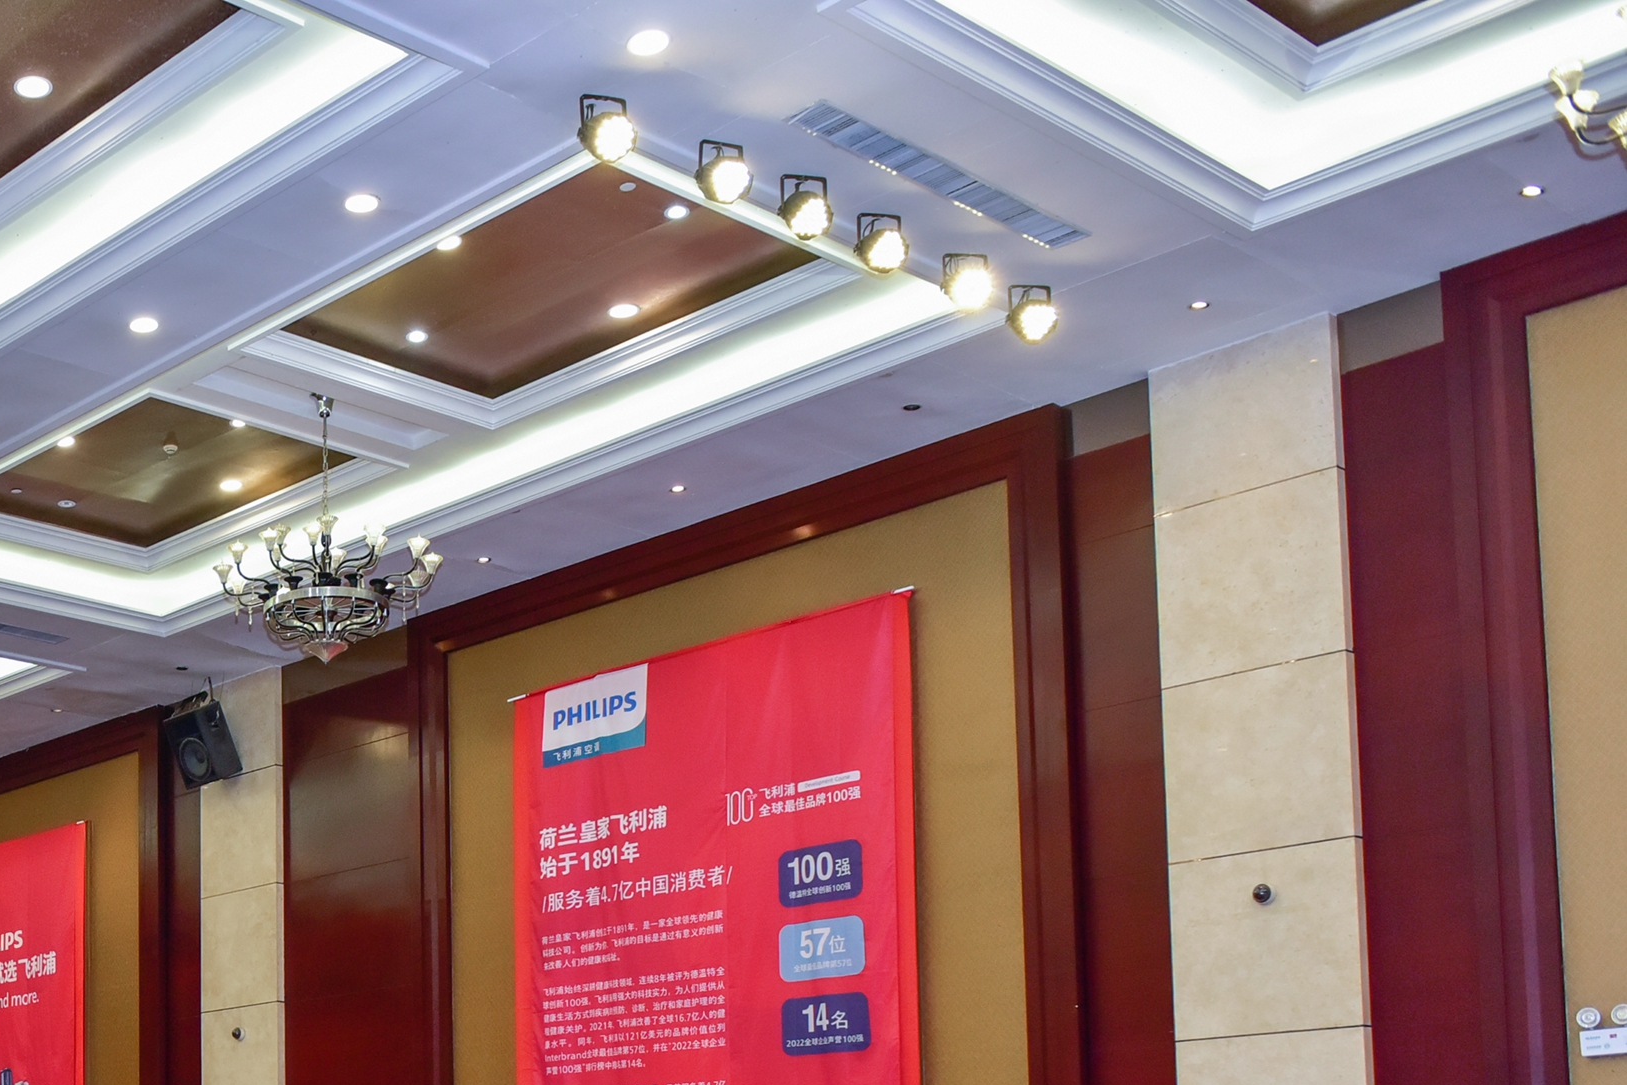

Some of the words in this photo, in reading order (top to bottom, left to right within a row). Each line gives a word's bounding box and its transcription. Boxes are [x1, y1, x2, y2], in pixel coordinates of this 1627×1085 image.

[553, 691, 637, 731] PHILIPS
[758, 782, 796, 800] 飞利浦
[758, 785, 862, 818] 全球最佳品牌100强
[539, 804, 668, 852] 荷兰皇家飞利浦
[539, 840, 641, 880] 始于1891年
